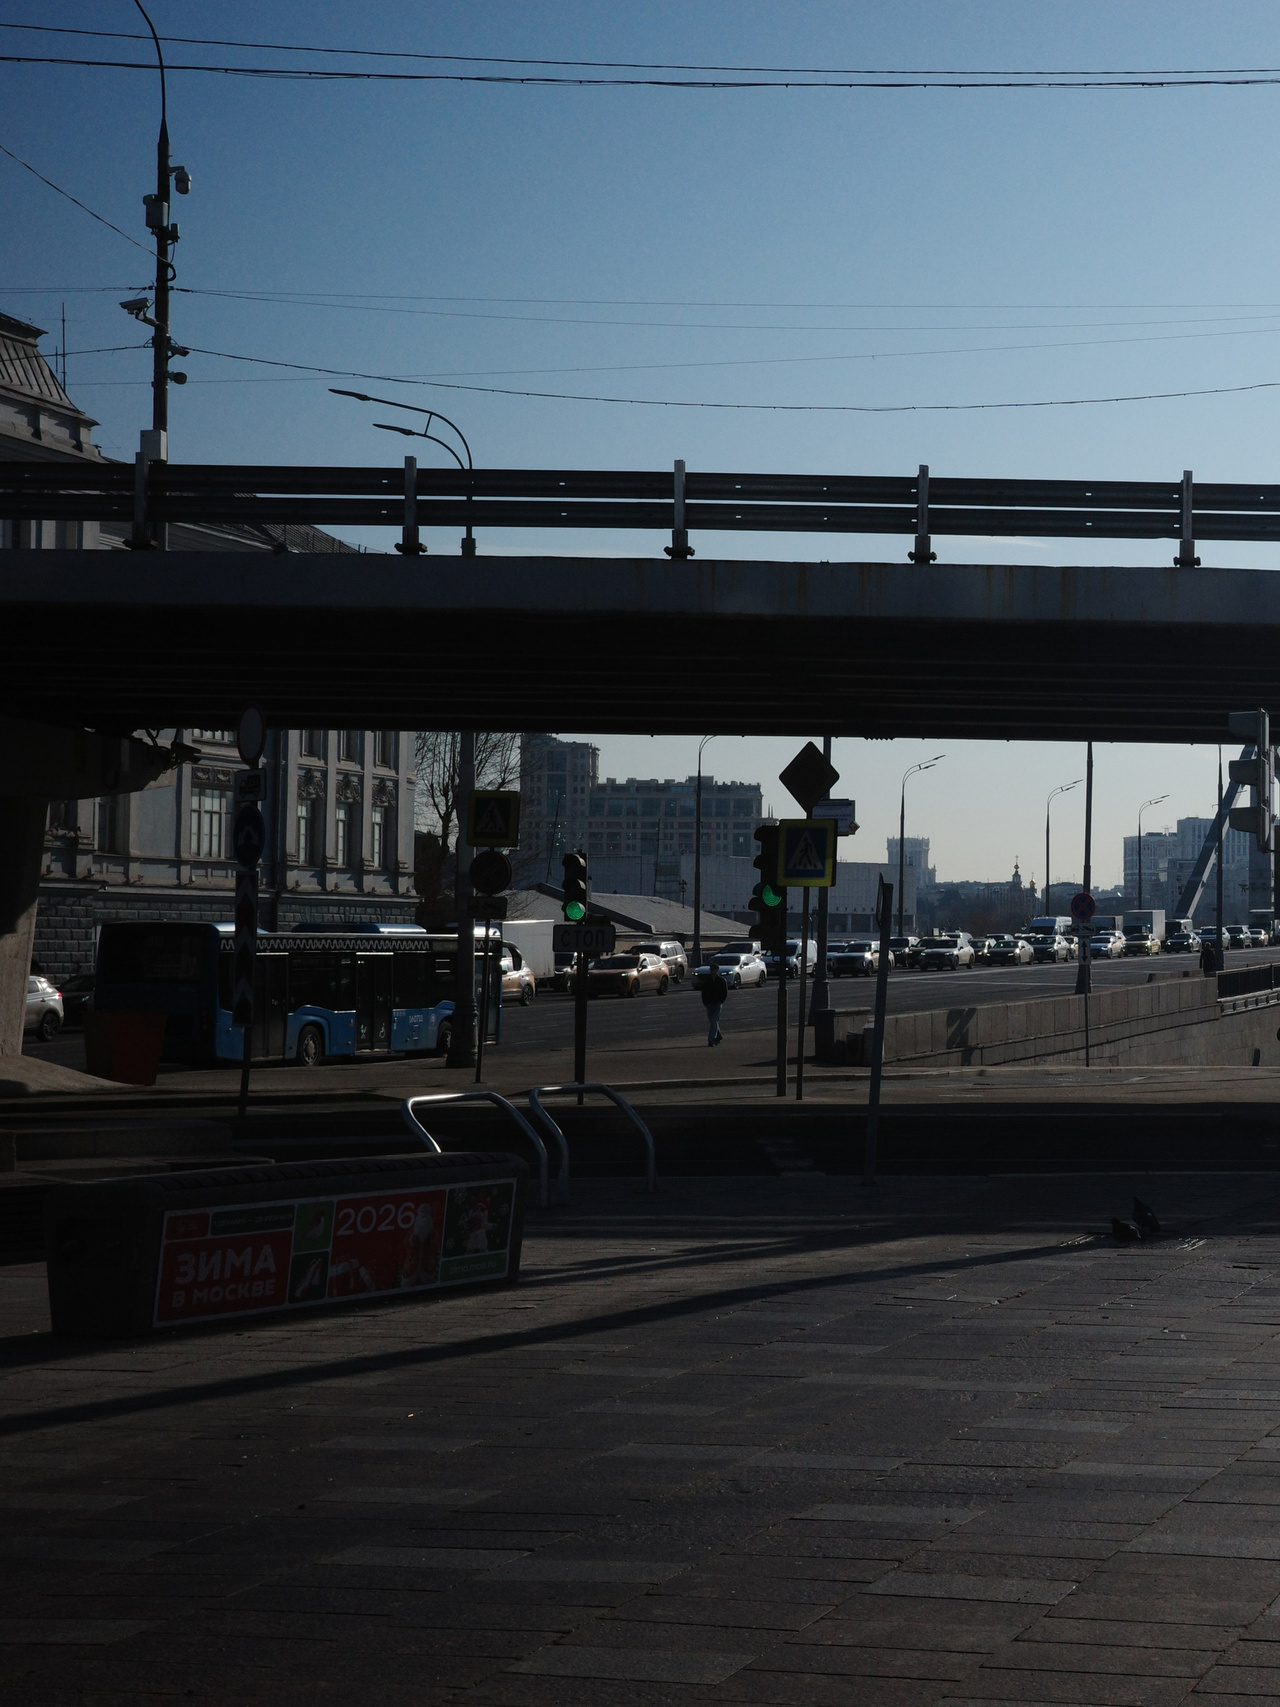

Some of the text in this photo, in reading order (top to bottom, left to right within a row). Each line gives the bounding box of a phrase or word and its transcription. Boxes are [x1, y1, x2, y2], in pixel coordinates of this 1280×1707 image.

[561, 930, 605, 948] СТОП
[336, 1201, 416, 1236] 2026
[174, 1244, 277, 1285] ЗИМА
[172, 1278, 277, 1308] В МОСКВЕ
